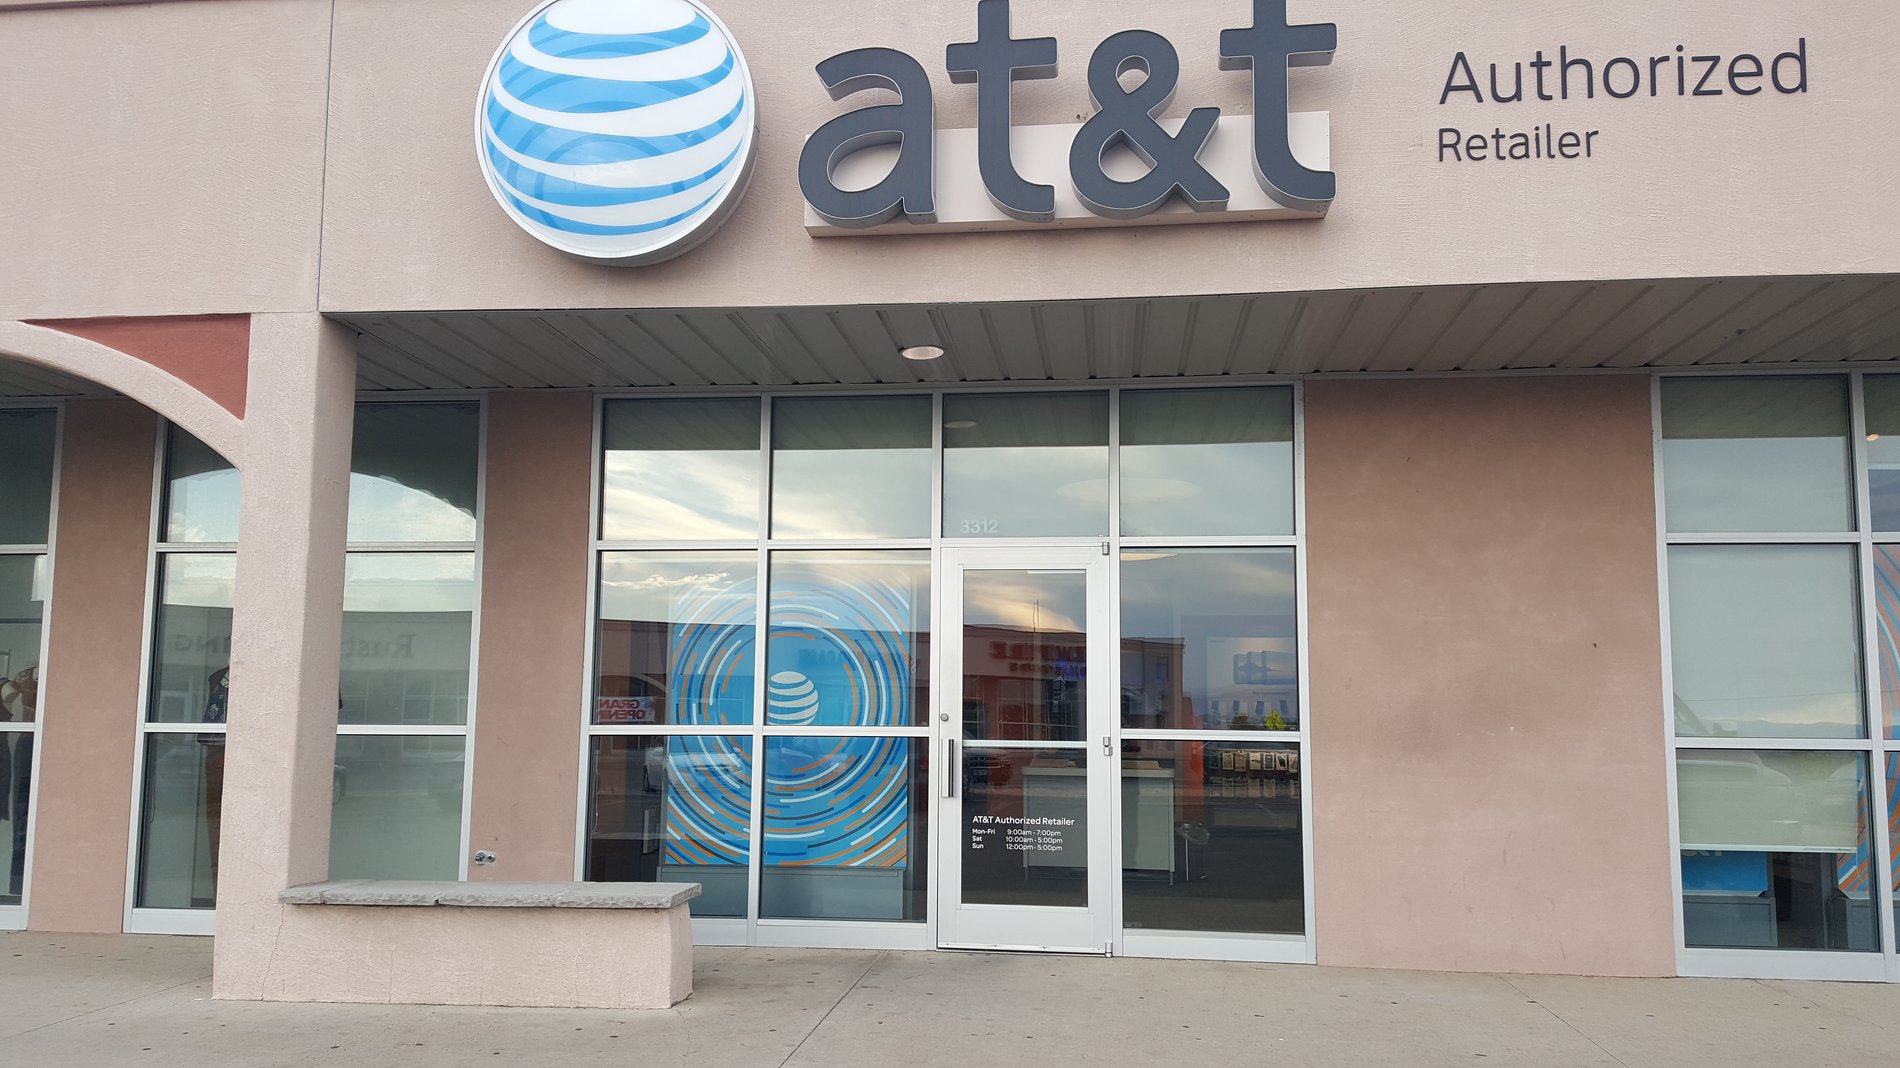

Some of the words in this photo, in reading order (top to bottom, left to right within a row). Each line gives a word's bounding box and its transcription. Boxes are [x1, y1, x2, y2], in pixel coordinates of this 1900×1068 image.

[1439, 37, 1808, 104] Authorized
[798, 0, 1339, 229] at&t
[1438, 123, 1600, 162] Retailer
[960, 519, 999, 534] 3312
[972, 815, 994, 824] AT&T
[995, 816, 1041, 826] Authorized
[1042, 817, 1075, 826] Retailer
